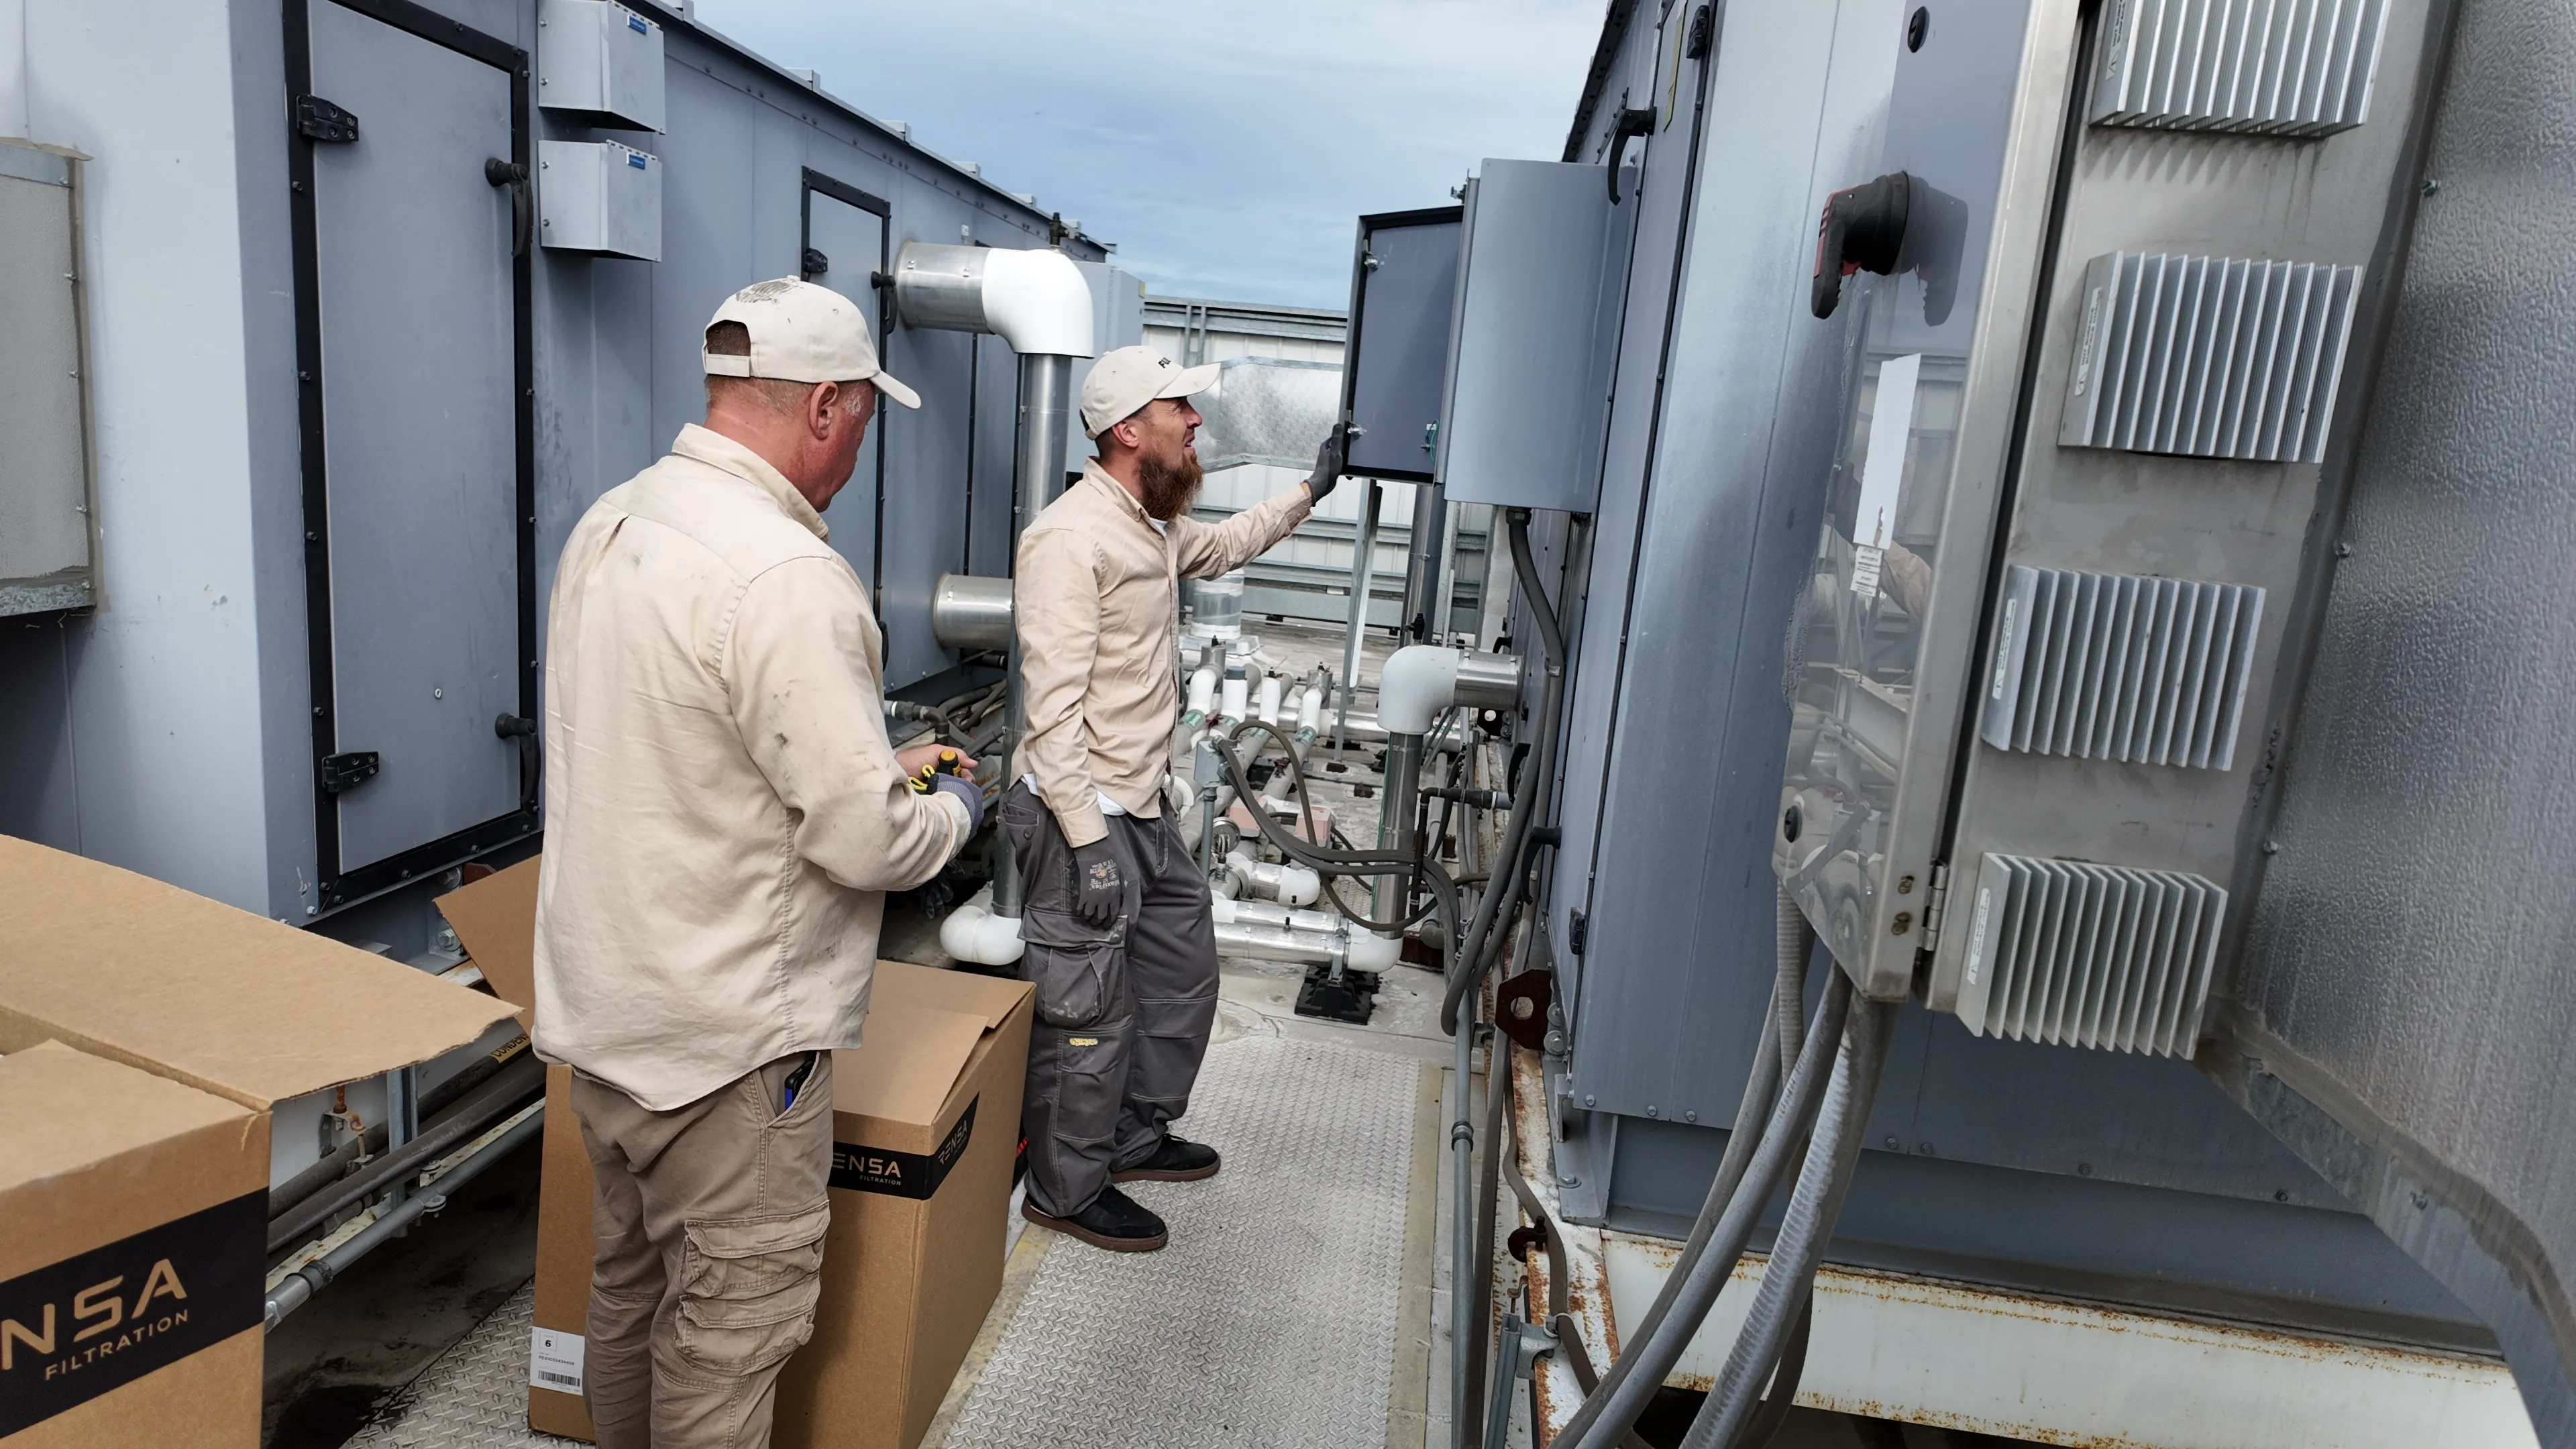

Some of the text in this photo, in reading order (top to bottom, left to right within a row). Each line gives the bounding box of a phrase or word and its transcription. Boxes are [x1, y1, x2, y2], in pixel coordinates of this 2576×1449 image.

[859, 1175, 902, 1186] FILTRATION
[1, 1258, 188, 1371] NSA
[44, 1309, 189, 1381] FILTRATION
